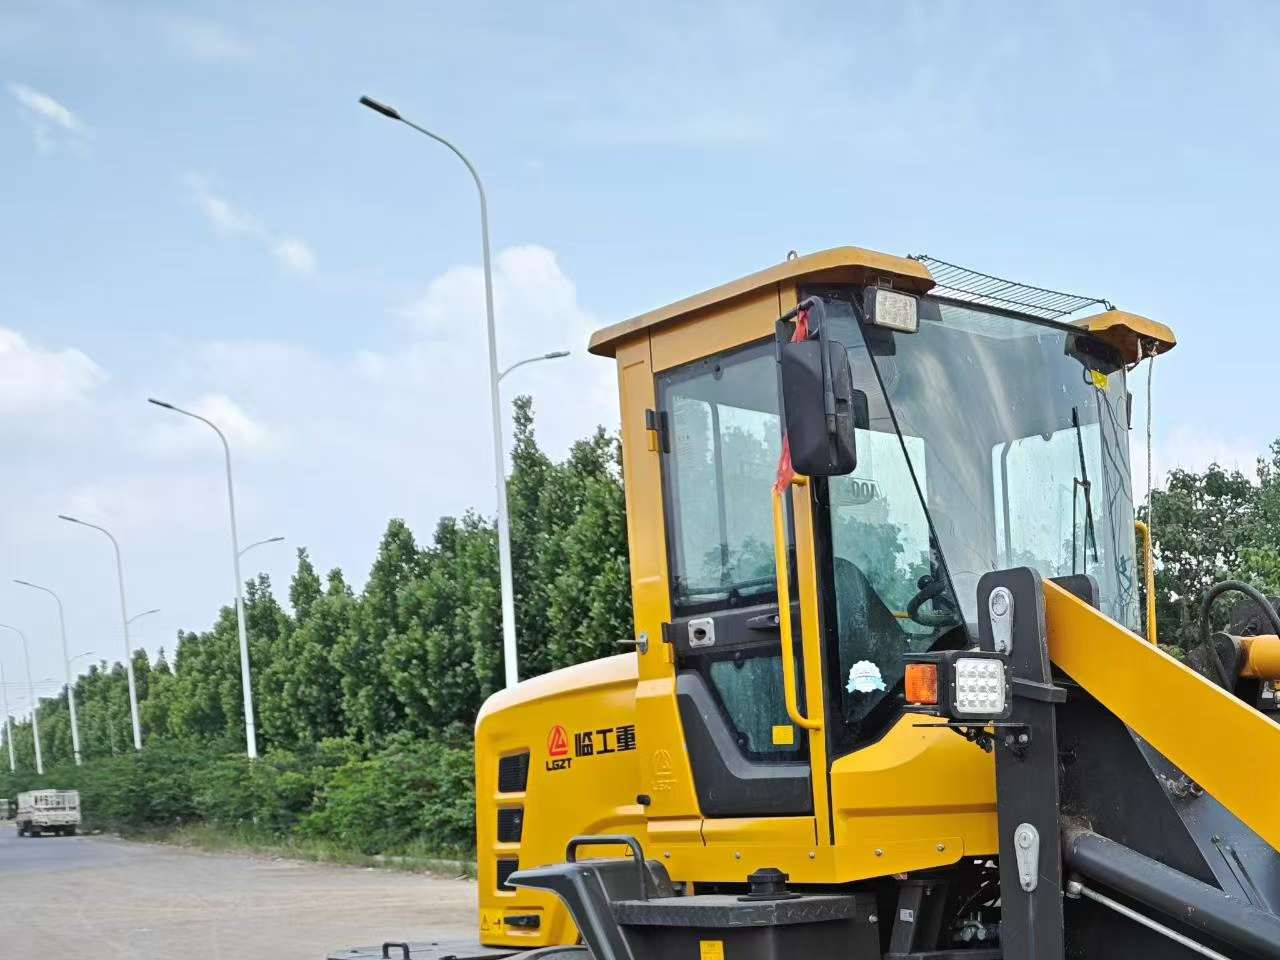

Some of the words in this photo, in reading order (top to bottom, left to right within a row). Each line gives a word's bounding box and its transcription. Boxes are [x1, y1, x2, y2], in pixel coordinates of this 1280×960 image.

[574, 725, 637, 757] 临工重
[546, 758, 572, 771] LGZT
